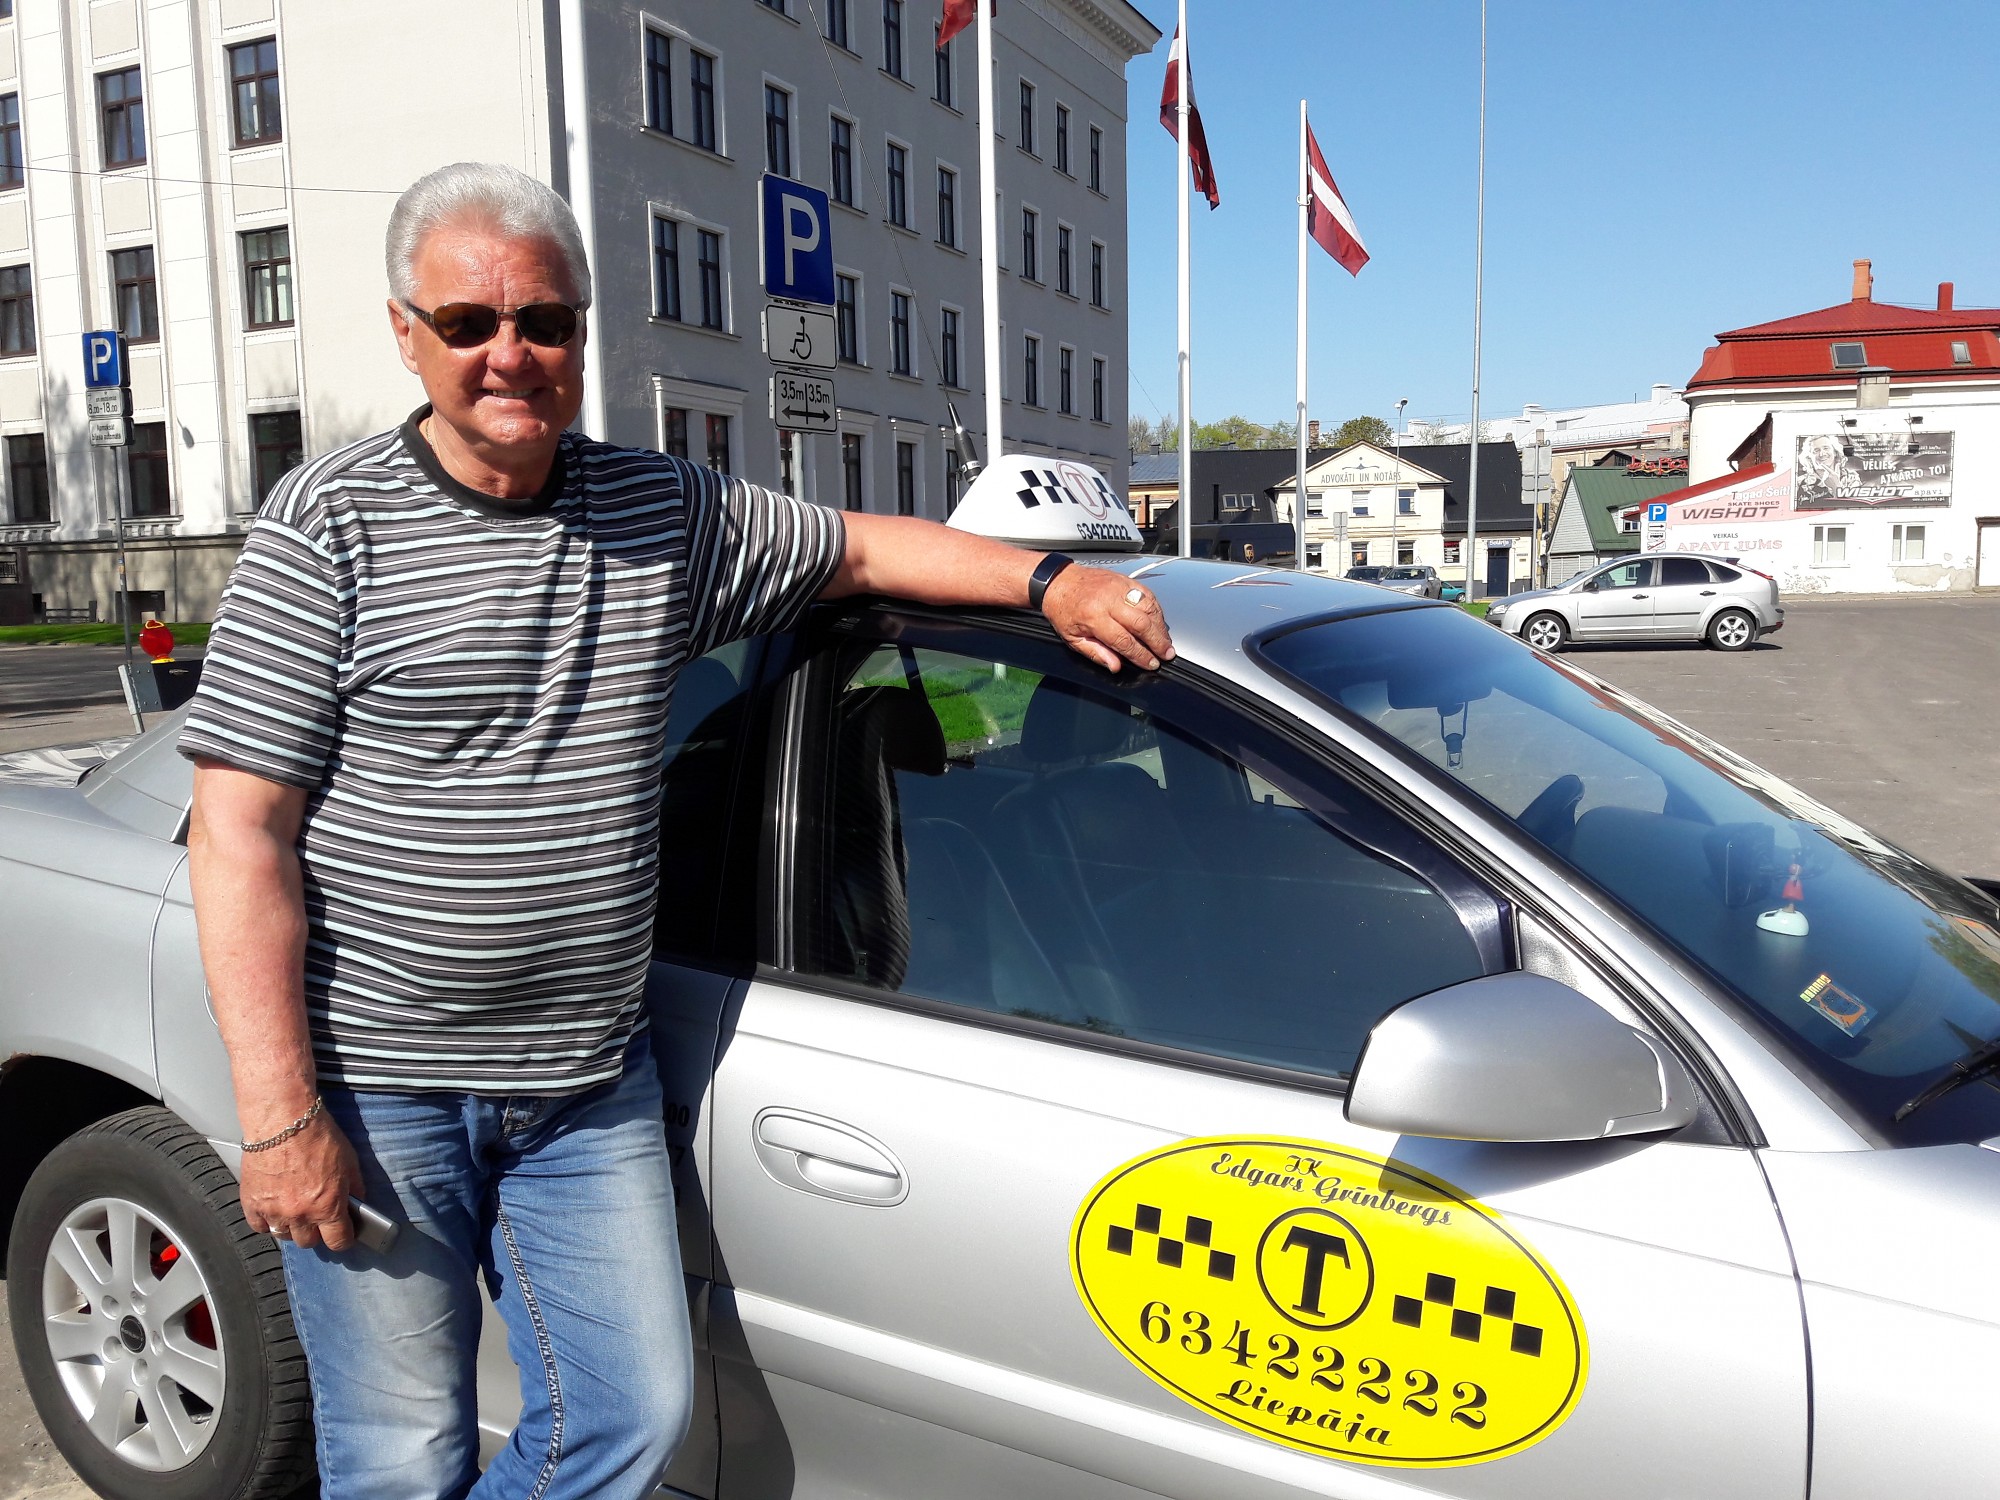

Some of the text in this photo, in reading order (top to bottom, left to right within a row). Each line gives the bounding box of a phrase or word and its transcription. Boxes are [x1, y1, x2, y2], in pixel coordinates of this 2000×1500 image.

[782, 193, 820, 286] P
[91, 338, 112, 381] P
[1862, 459, 1897, 471] VĒLIES,
[1321, 472, 1355, 484] ADVOKĀTI
[1360, 472, 1370, 482] UN
[1881, 469, 1924, 485] ATKĀRTO
[1065, 472, 1099, 507] T
[1732, 488, 1762, 501] Tagad
[1836, 486, 1914, 498] WISHOT
[1914, 489, 1943, 497] apavi
[1652, 505, 1665, 521] P
[1682, 506, 1780, 520] WISHOT
[1077, 523, 1132, 541] 63422222
[1676, 539, 1783, 551] APAVI JUMS
[1211, 1153, 1452, 1226] Edgars Grīnbergs
[1280, 1225, 1353, 1319] T
[1140, 1301, 1488, 1430] 63422222
[1215, 1379, 1392, 1446] Liepāja
